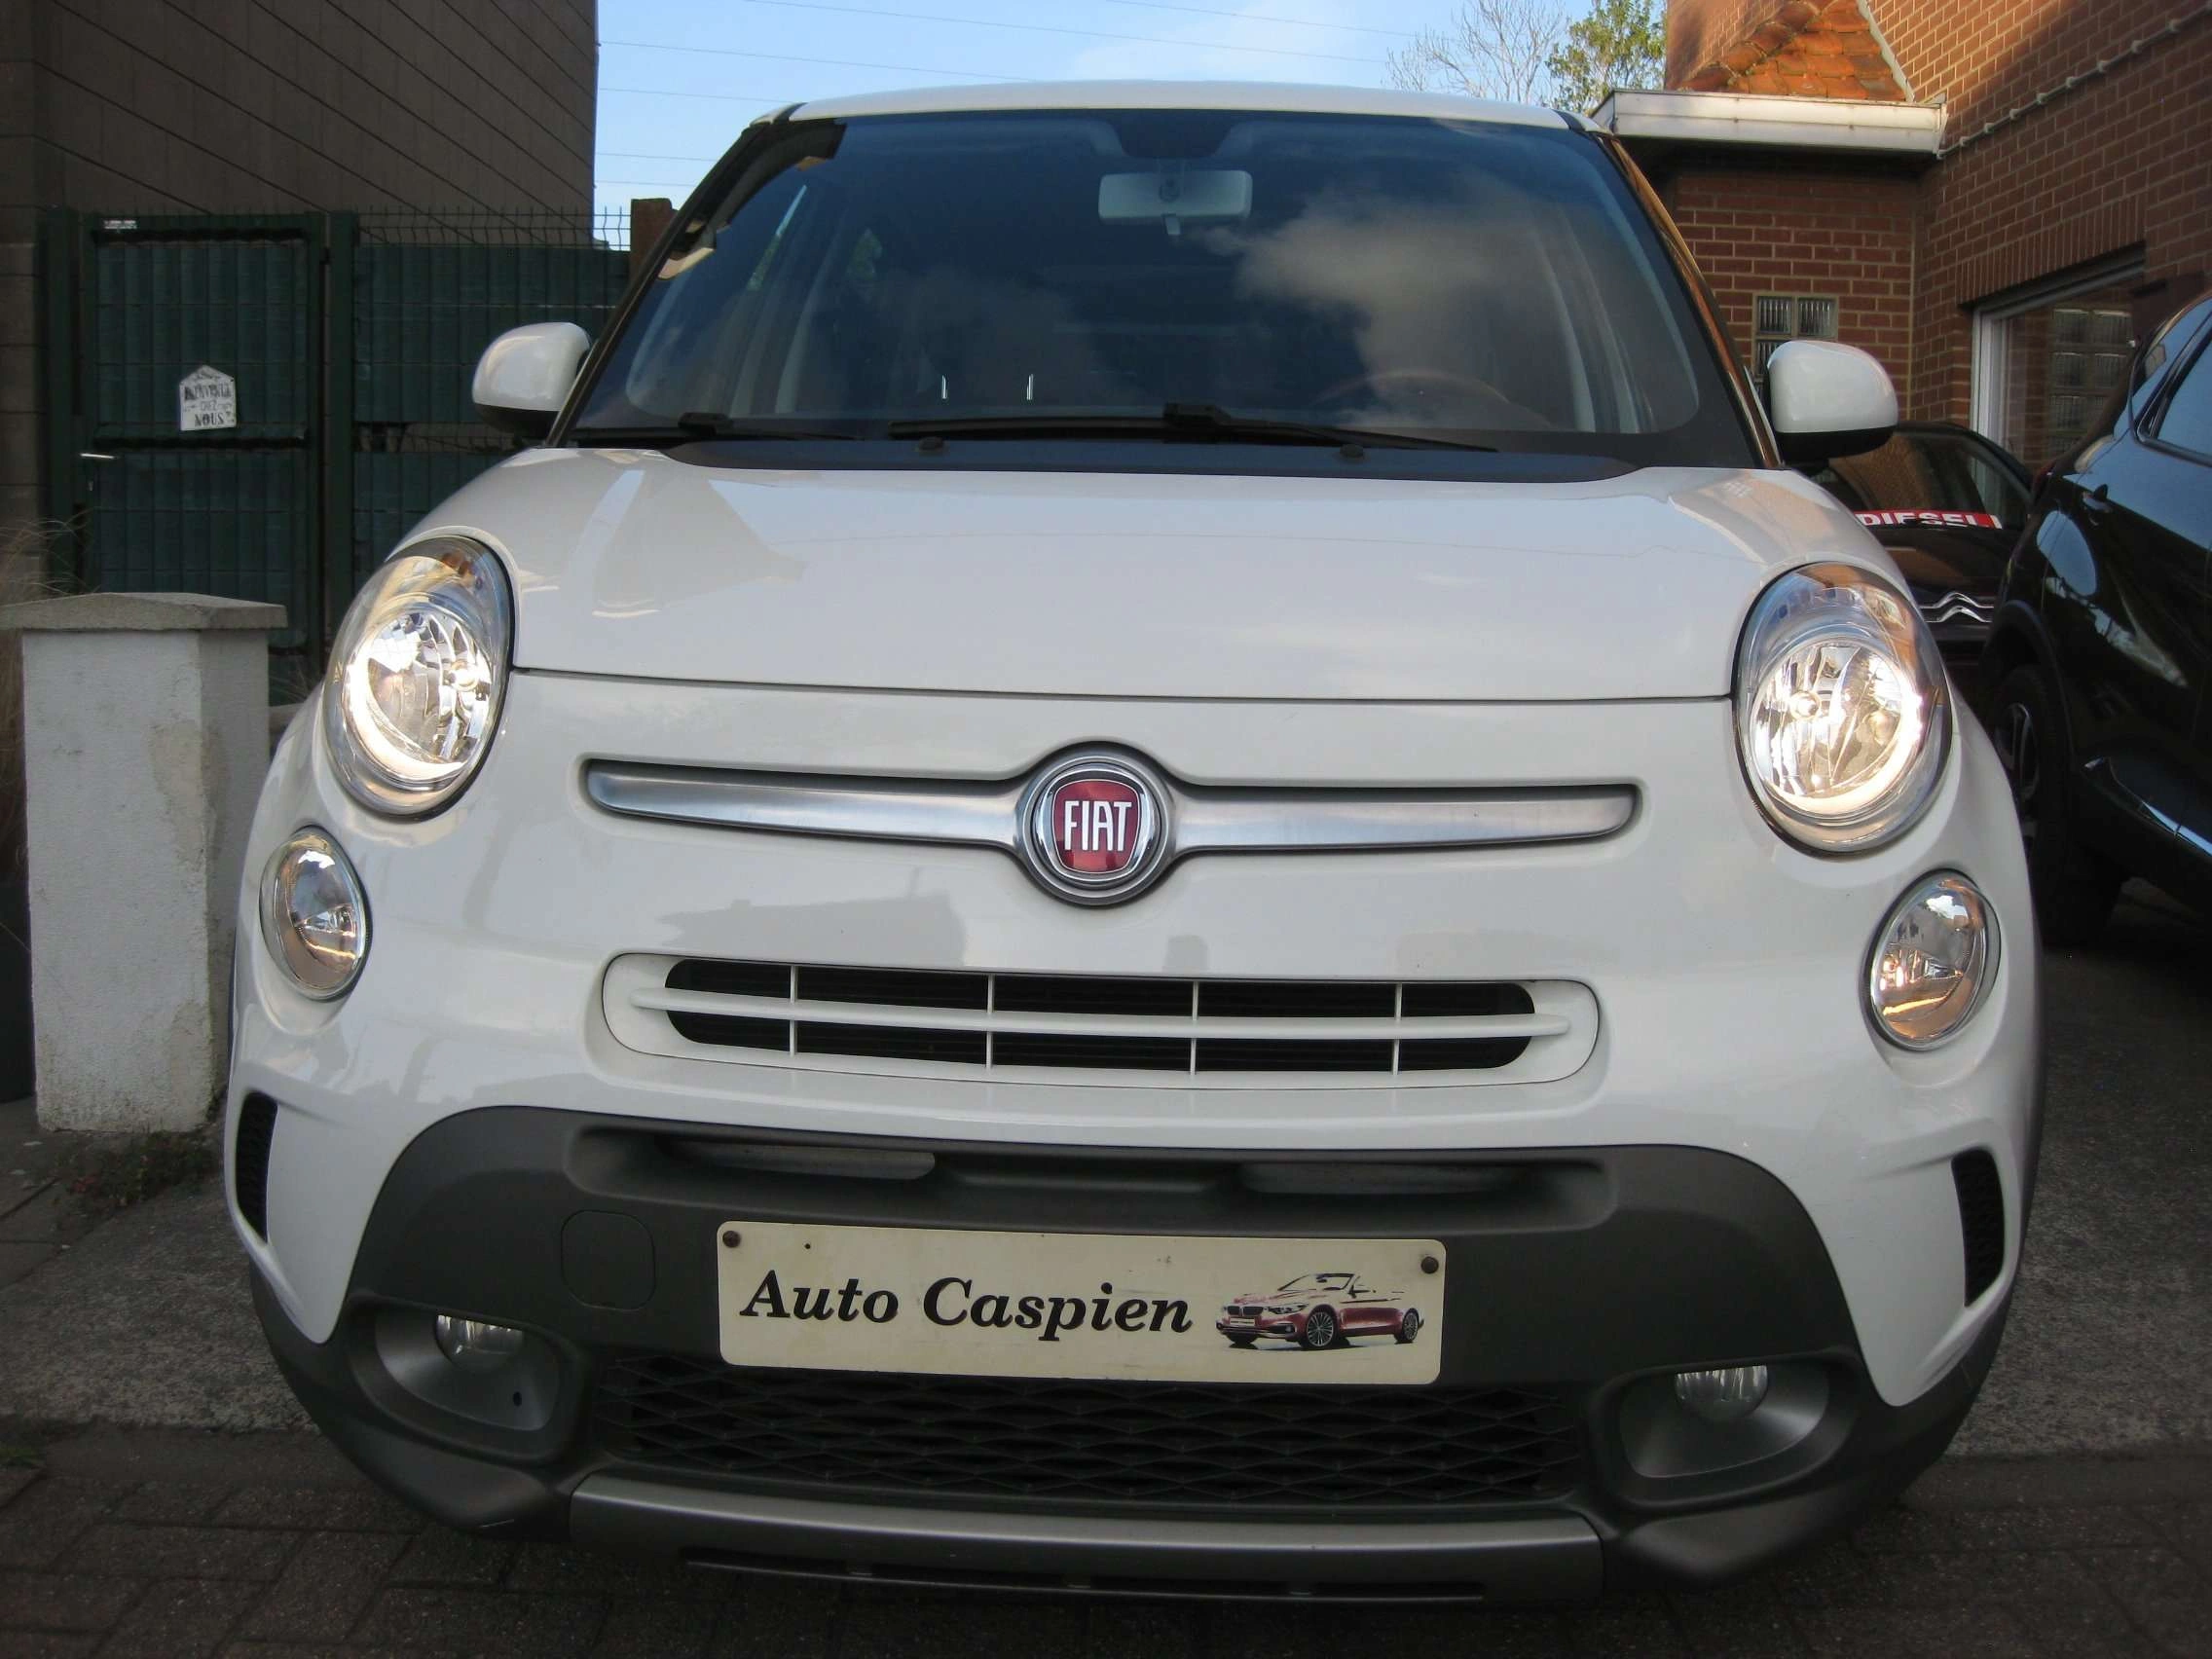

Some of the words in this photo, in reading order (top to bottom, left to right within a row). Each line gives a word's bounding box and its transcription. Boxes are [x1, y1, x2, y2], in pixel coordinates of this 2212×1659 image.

[195, 413, 225, 426] NOUS
[1855, 512, 1989, 528] DIESEL
[1064, 799, 1132, 852] FIAT
[739, 1269, 899, 1324] Auto
[923, 1276, 1194, 1342] Caspien
